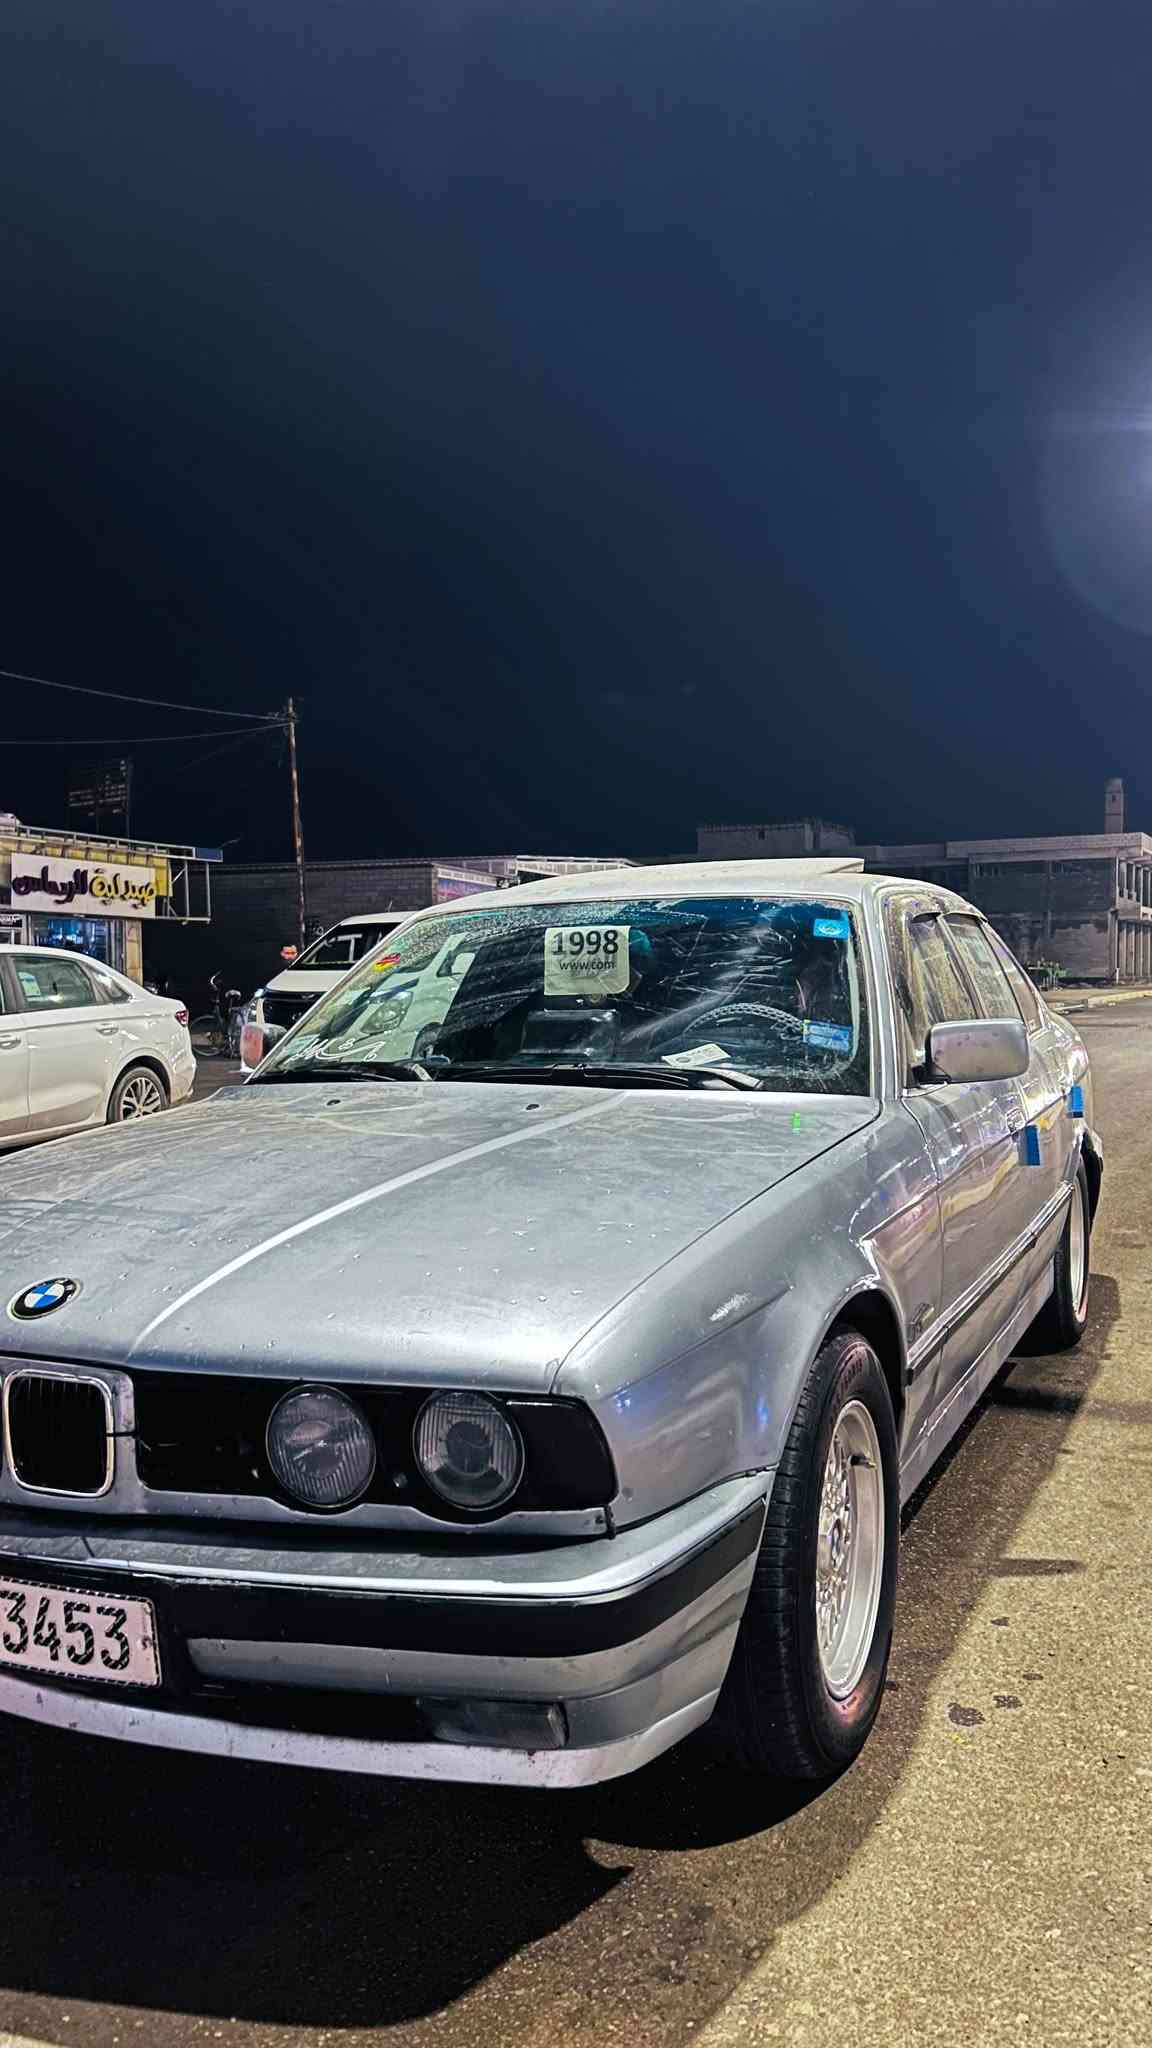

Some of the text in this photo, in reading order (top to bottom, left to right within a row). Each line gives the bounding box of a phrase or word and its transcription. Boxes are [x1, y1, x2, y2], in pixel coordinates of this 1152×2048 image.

[89, 868, 155, 909] صيدلية
[552, 929, 619, 955] 1998
[560, 960, 615, 970] www.com
[0, 1590, 130, 1670] 3453
